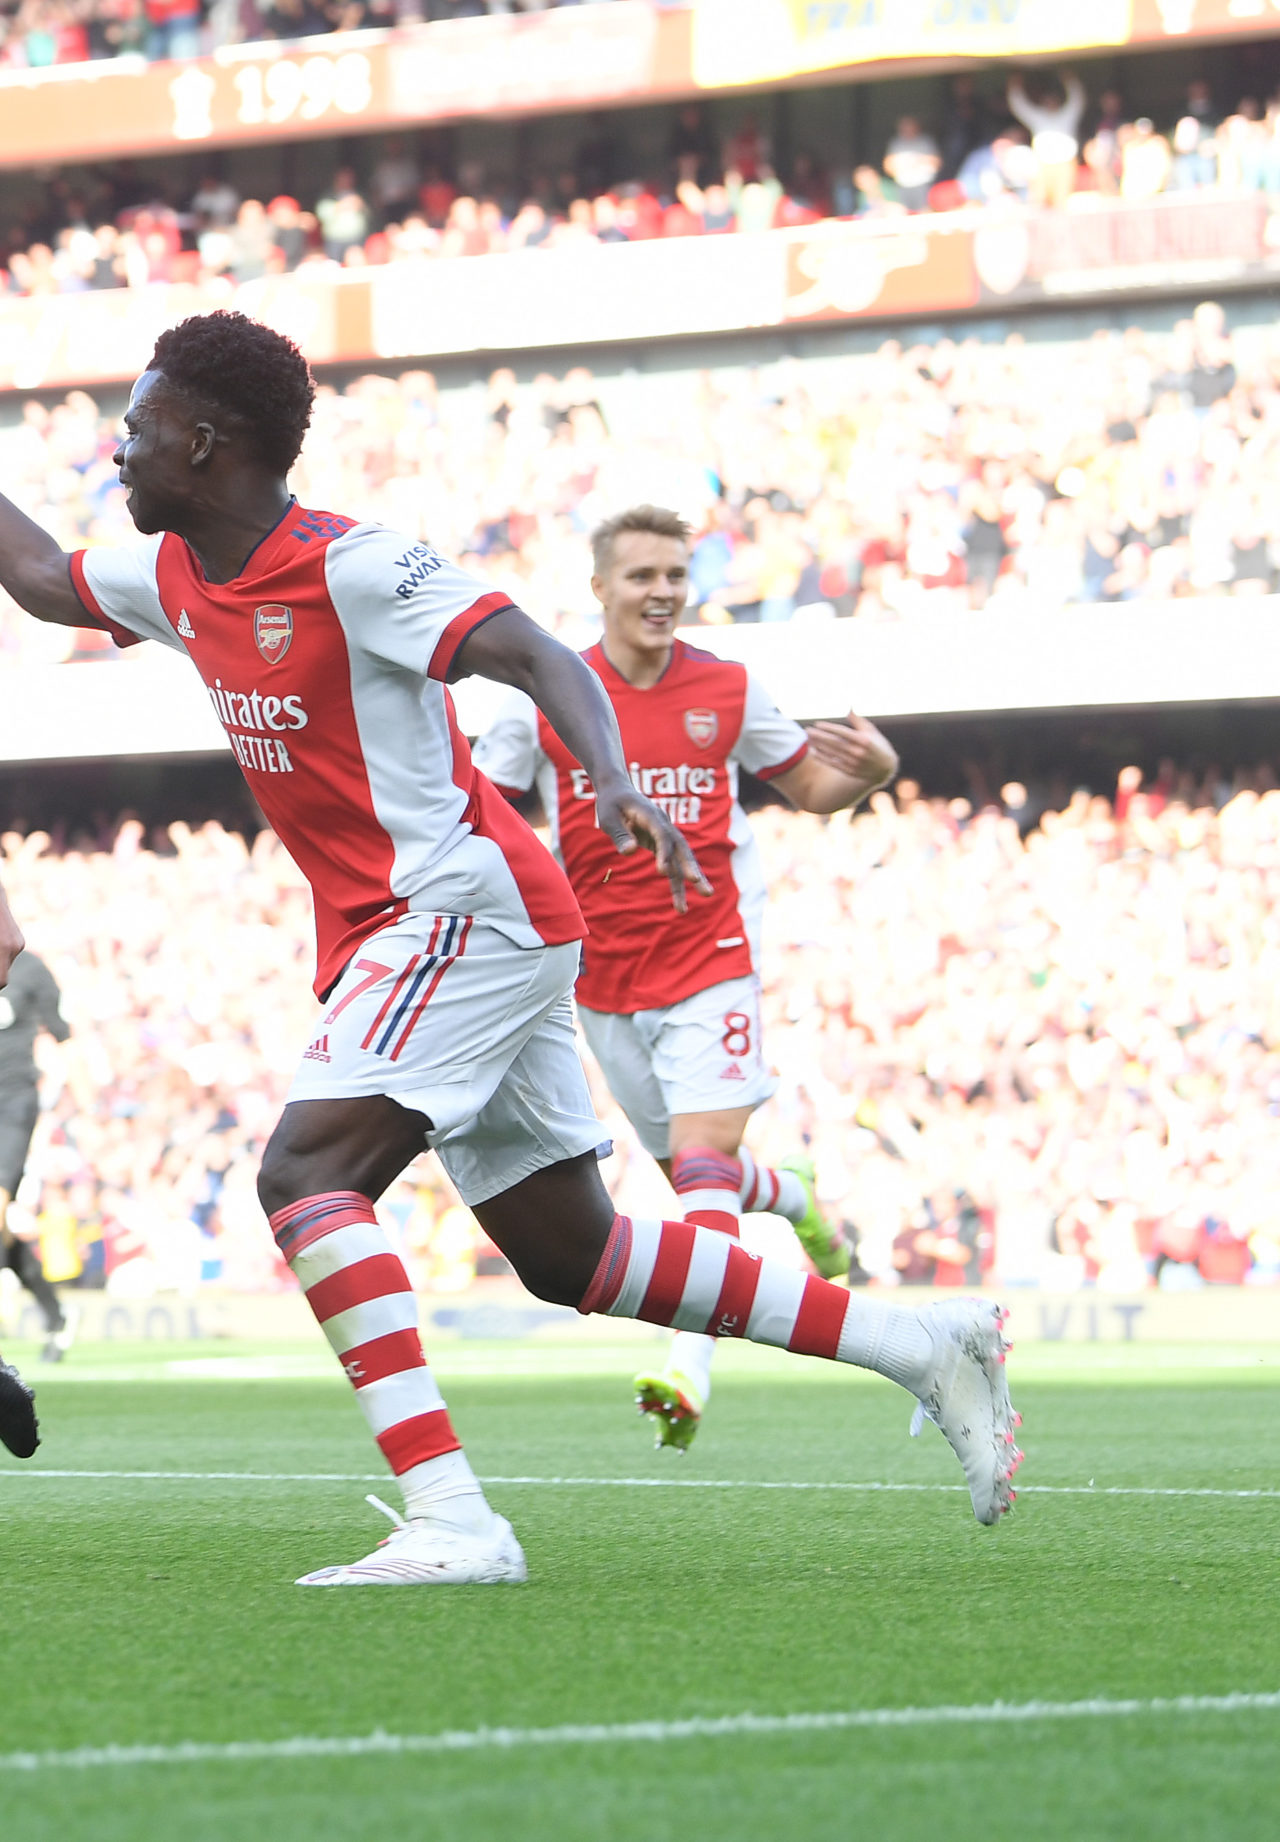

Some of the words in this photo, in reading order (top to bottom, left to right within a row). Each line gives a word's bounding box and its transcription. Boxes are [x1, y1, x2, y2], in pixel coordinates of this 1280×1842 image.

[208, 678, 309, 731] irates
[231, 733, 294, 772] BETTER
[570, 761, 716, 799] Eirates
[324, 959, 395, 1025] 7
[723, 1012, 750, 1056] 8
